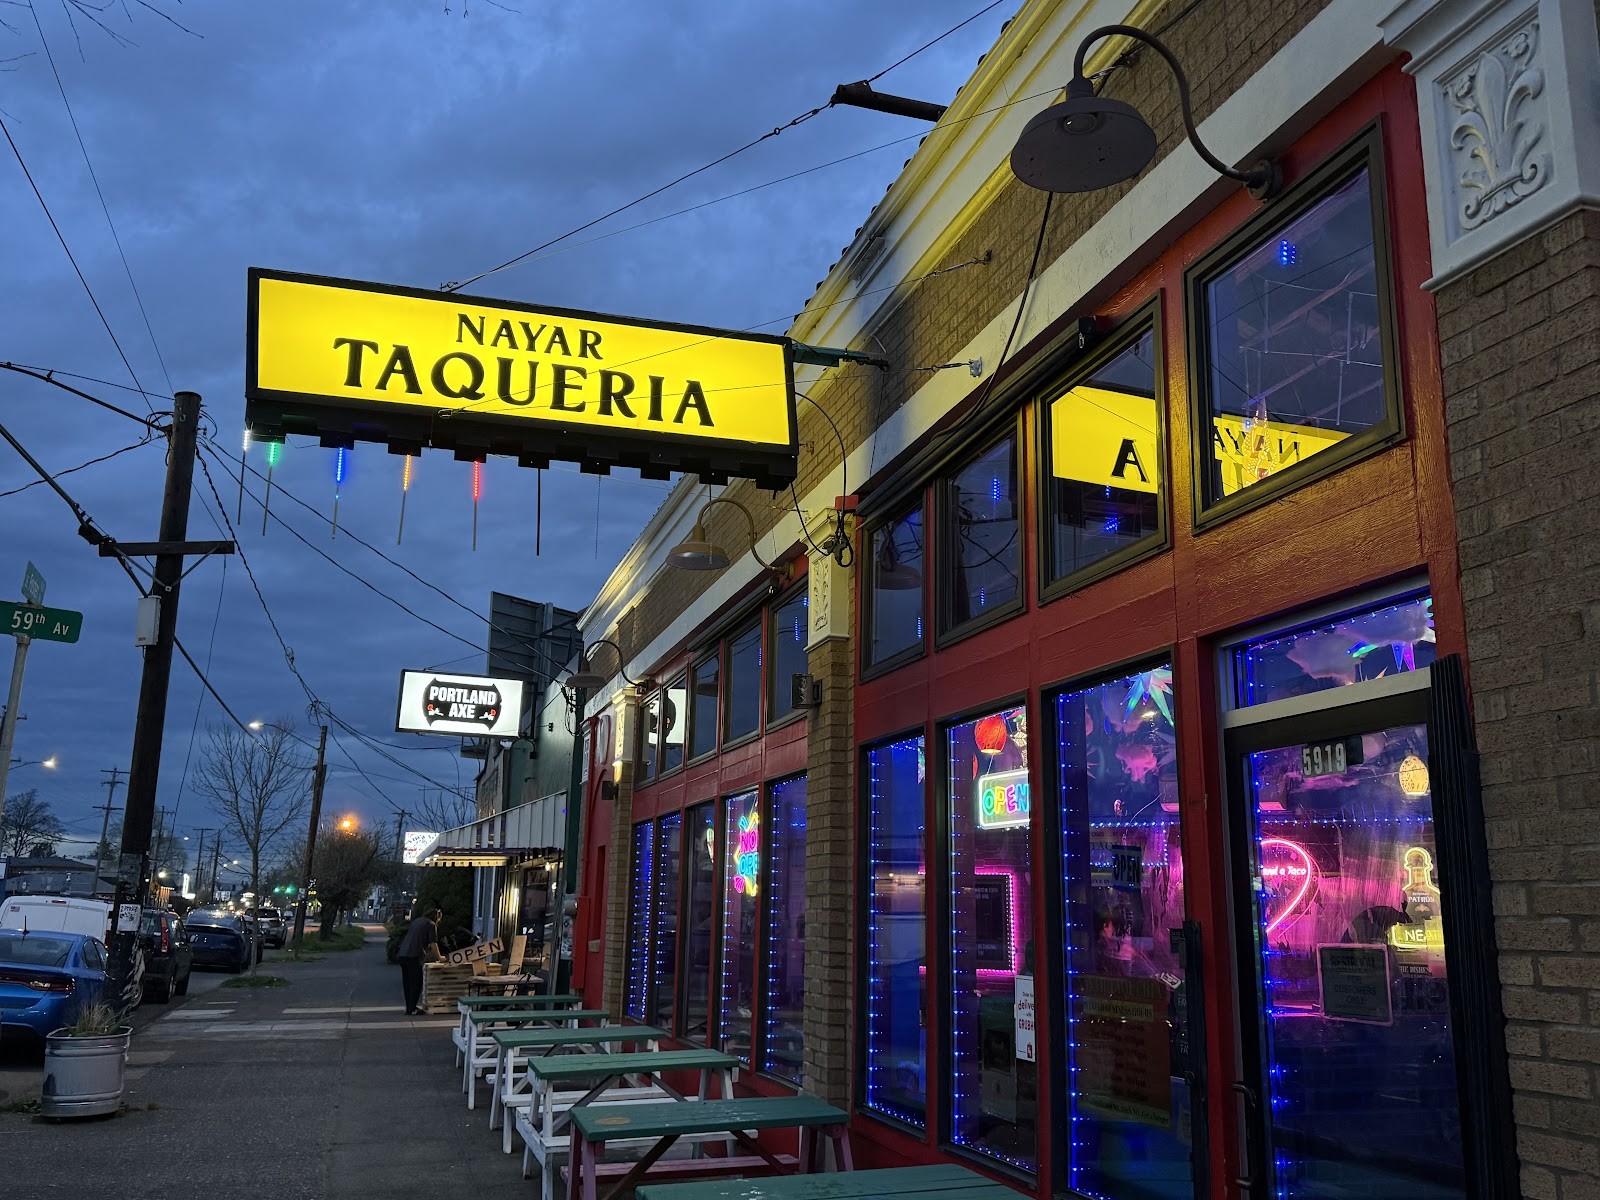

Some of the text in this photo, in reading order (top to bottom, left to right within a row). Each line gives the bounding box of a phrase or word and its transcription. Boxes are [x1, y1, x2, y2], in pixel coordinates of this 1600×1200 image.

[456, 312, 604, 361] NAYAR
[333, 336, 716, 428] TAQUERIA
[11, 610, 46, 631] 59th
[429, 686, 497, 706] PORTLAND
[448, 703, 476, 719] AXE
[1302, 742, 1345, 776] 5919
[982, 783, 1030, 817] OPEN
[739, 829, 759, 855] NO
[738, 851, 759, 877] OPE
[1112, 852, 1141, 883] OPEN
[1287, 865, 1307, 876] Taco
[452, 940, 502, 964] OPEN
[1018, 1000, 1034, 1011] delive
[1018, 1018, 1034, 1031] GRUBH
